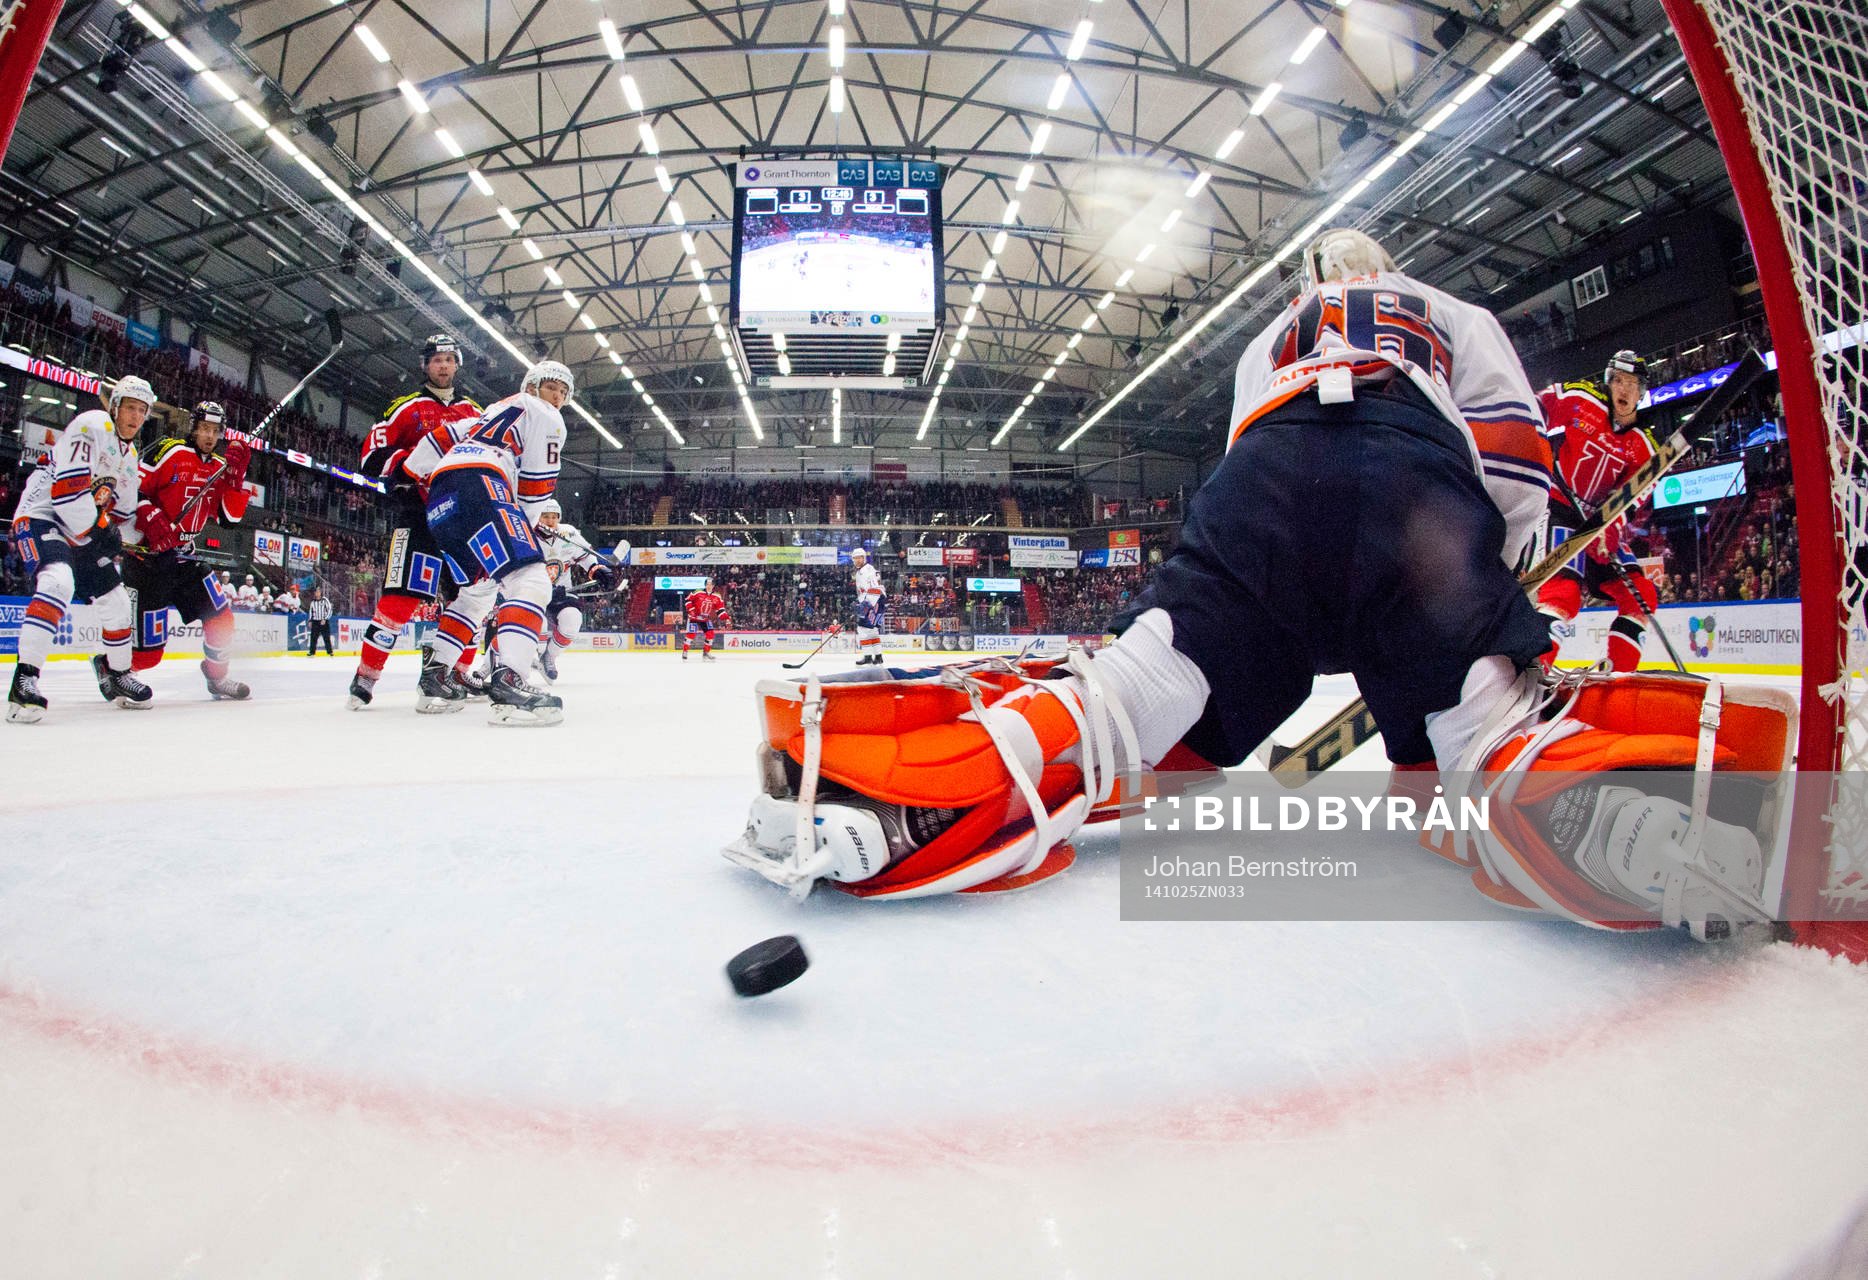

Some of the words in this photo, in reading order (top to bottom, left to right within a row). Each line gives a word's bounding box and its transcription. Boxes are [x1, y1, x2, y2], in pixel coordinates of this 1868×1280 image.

[764, 169, 789, 179] Grant
[790, 169, 831, 179] Thornton
[369, 428, 388, 449] 15
[70, 439, 91, 464] 79
[453, 445, 485, 455] SPORT
[258, 537, 281, 554] ELON
[1012, 537, 1066, 549] Vintergatan
[291, 542, 319, 562] ELON
[665, 551, 697, 561] Swegon
[741, 637, 771, 648] Nolato
[1718, 626, 1800, 645] MÅLERIBUTIKEN
